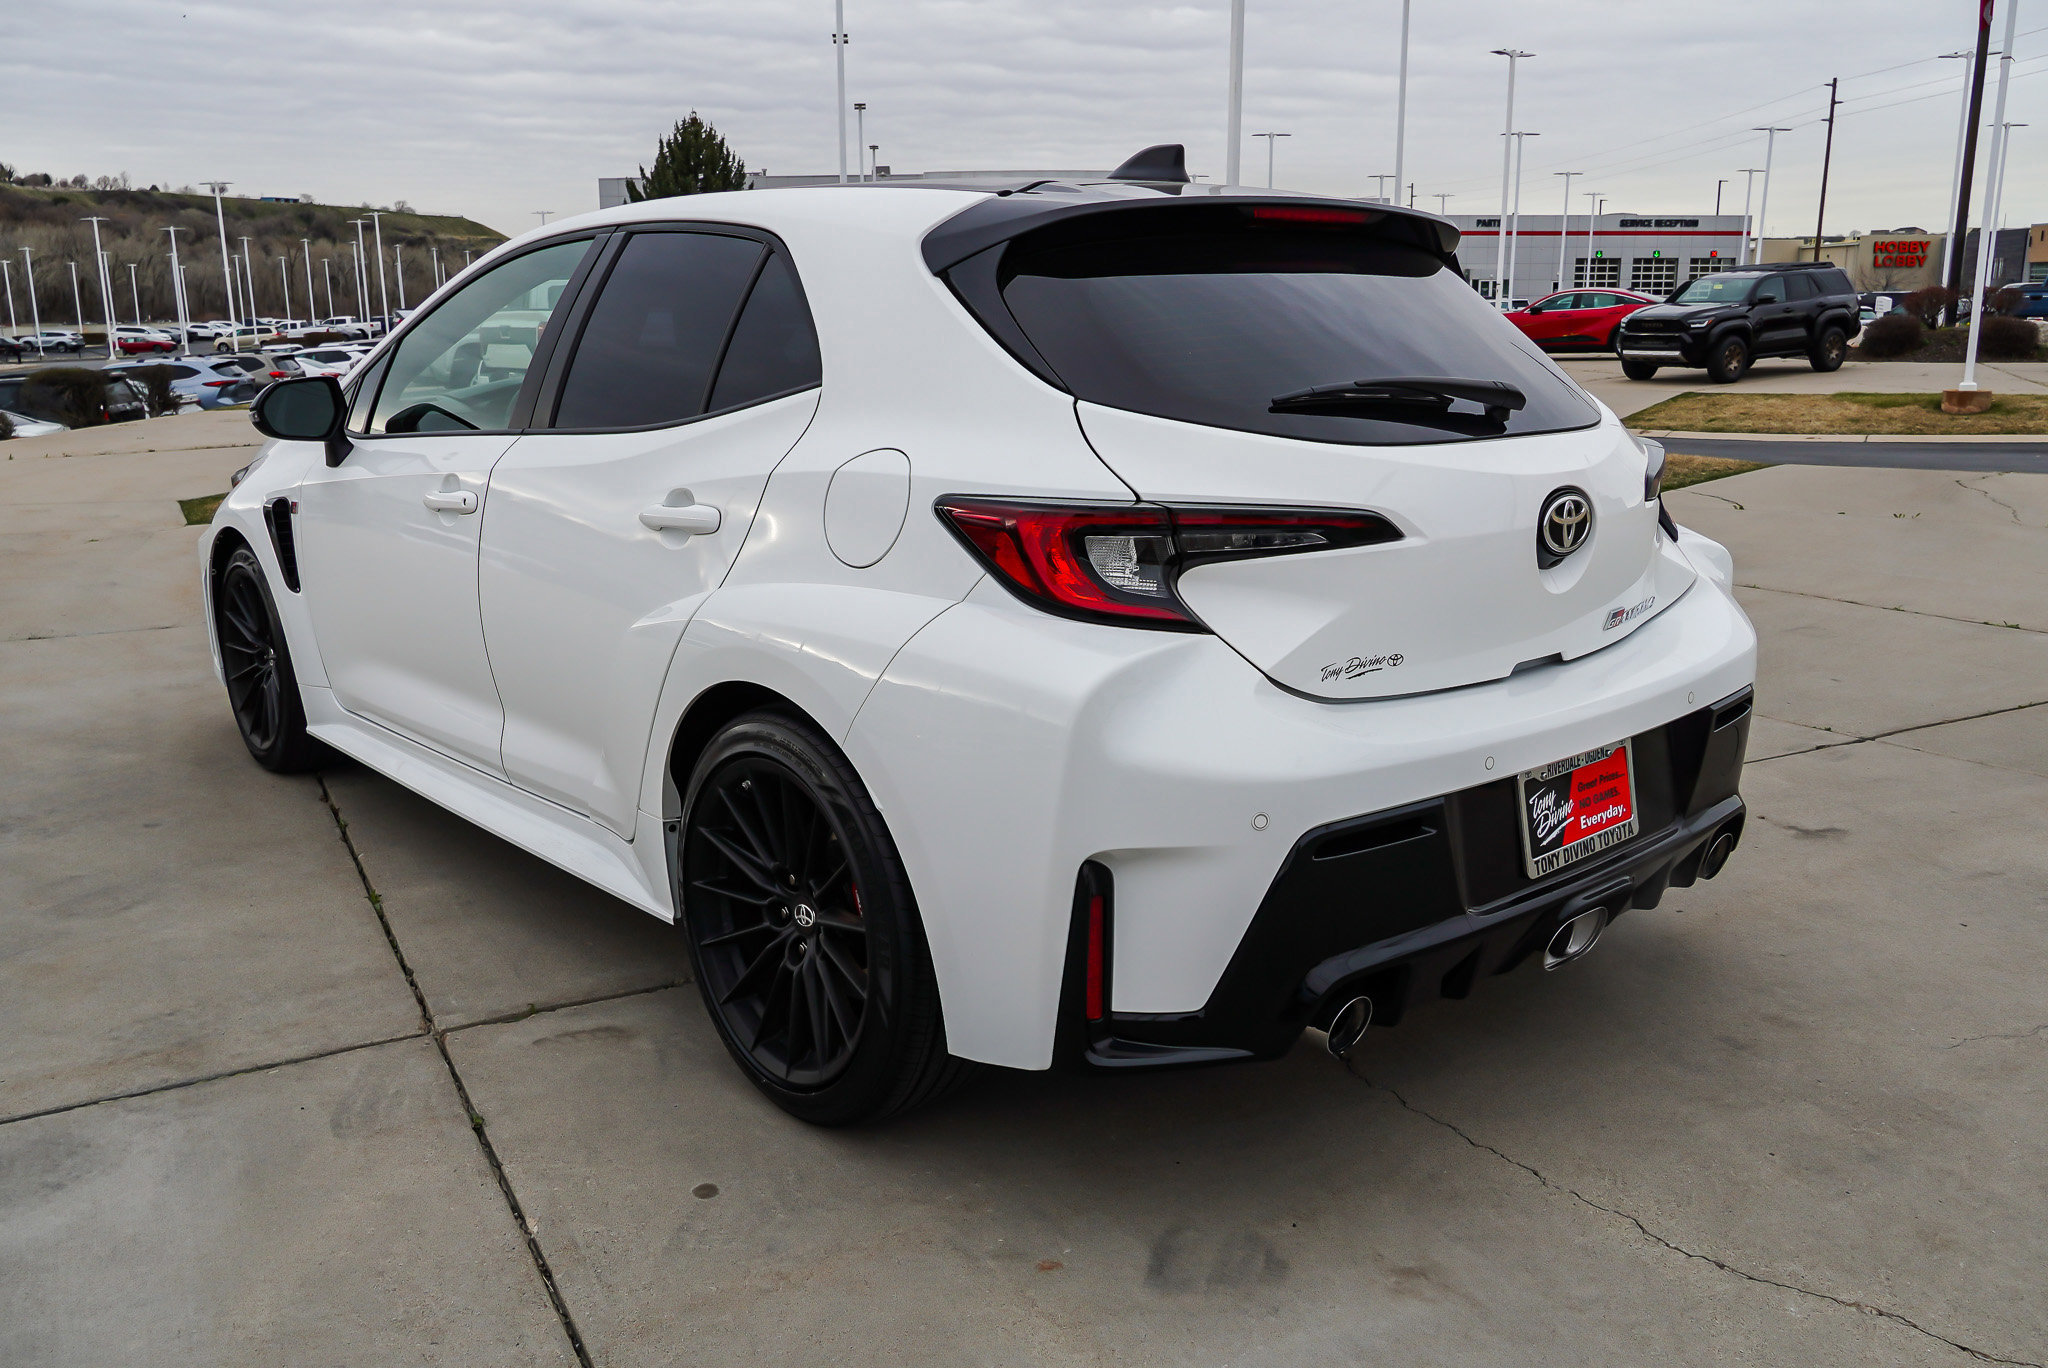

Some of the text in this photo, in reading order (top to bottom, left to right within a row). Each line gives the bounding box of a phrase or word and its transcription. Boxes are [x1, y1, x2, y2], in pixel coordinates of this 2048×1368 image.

[1619, 219, 1699, 227] SERVICE RECEPTION
[1874, 241, 1930, 253] HOBBY
[1874, 255, 1928, 268] LOBBY
[1320, 654, 1386, 682] Tony Divino
[1547, 755, 1581, 778] RIVERDALE
[1577, 777, 1598, 793] Great
[1529, 787, 1556, 819] Tony
[1579, 796, 1592, 809] NO
[1532, 799, 1575, 838] Divino
[1580, 804, 1626, 829] Everyday.
[1534, 820, 1635, 876] TONY DIVINO TOYOTA
